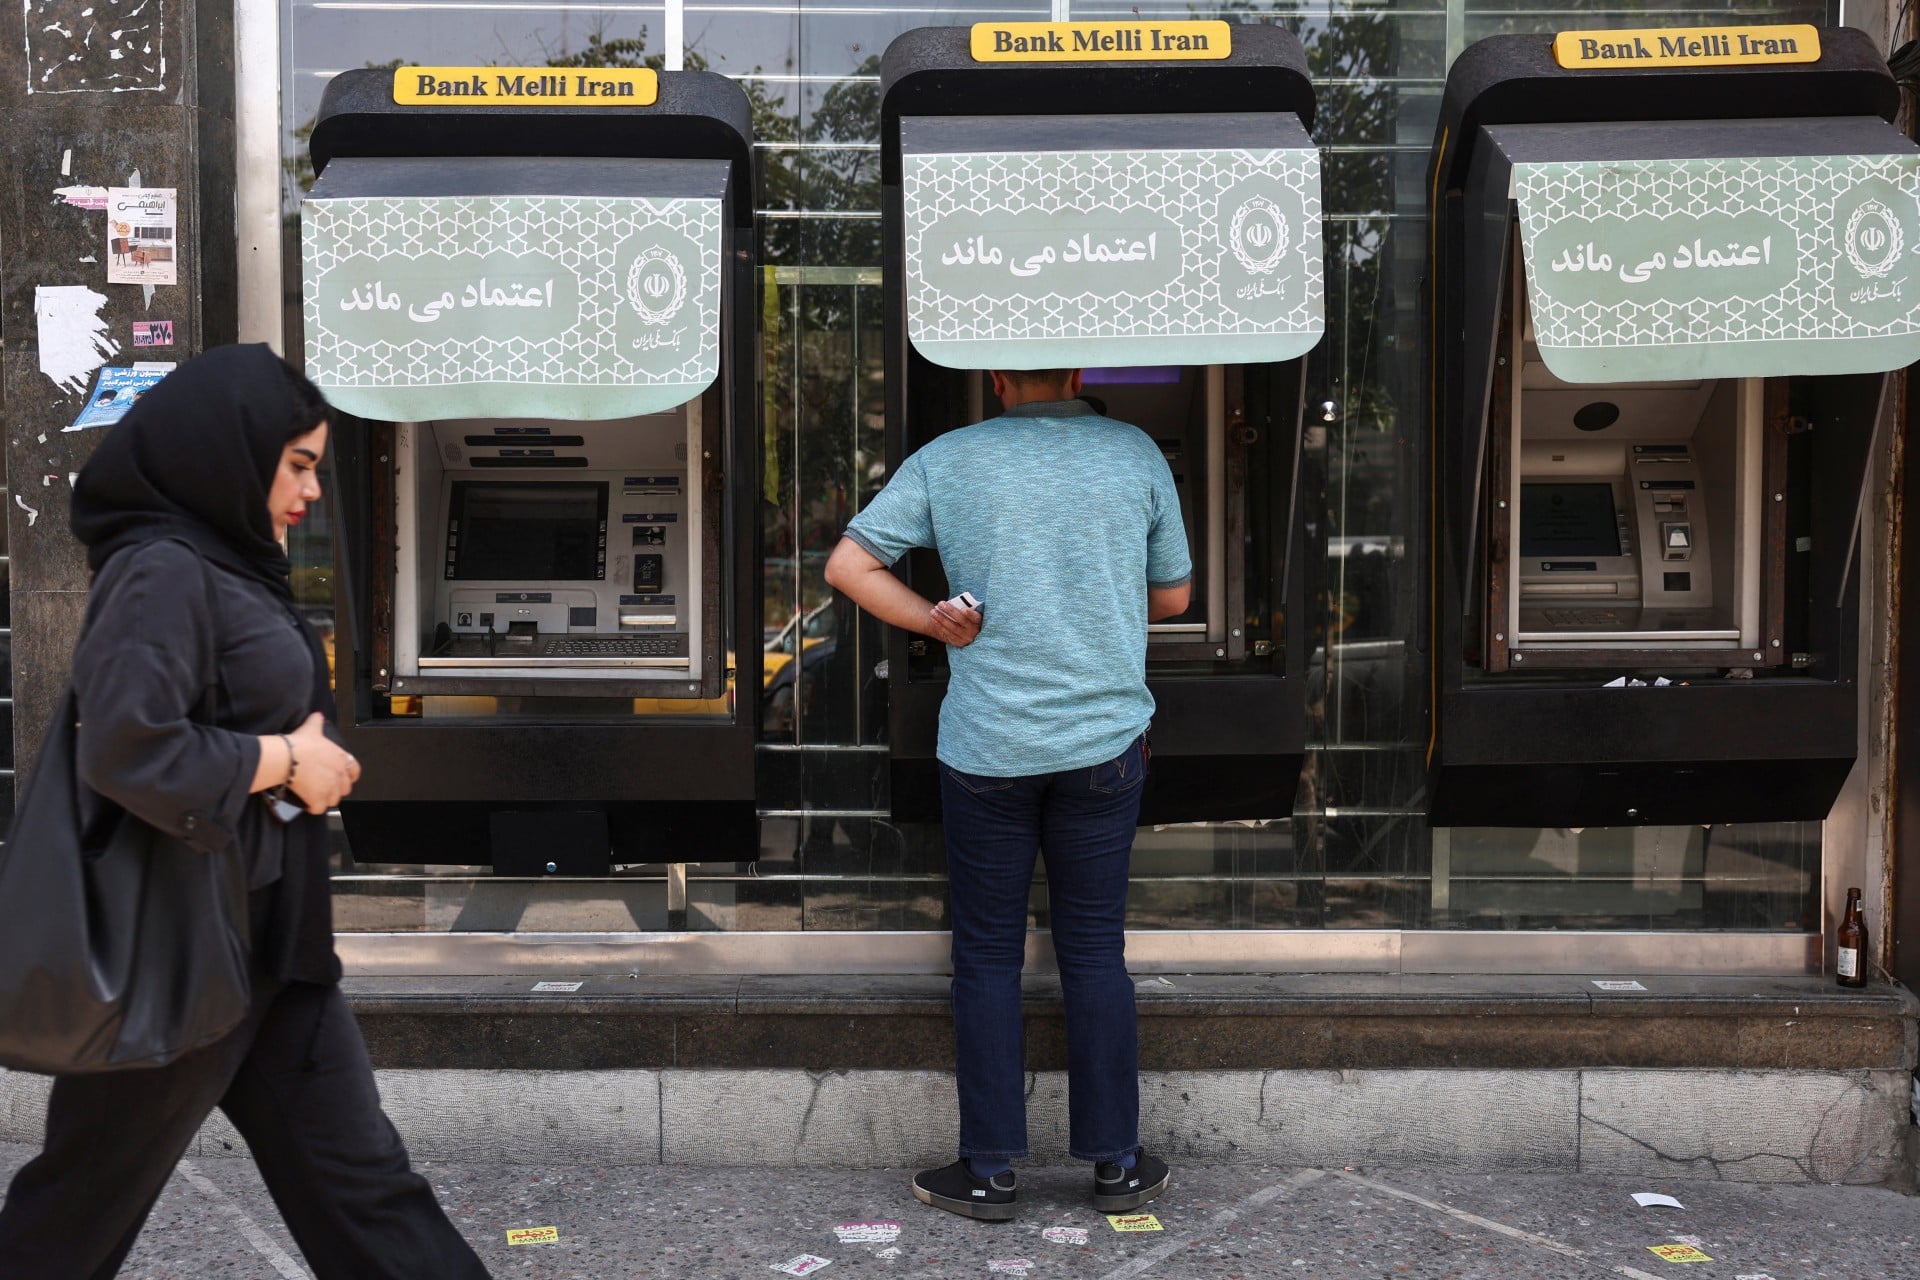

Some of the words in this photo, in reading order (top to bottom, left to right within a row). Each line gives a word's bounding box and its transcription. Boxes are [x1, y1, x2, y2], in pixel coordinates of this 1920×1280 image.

[993, 30, 1065, 52] Bank
[1072, 29, 1142, 51] Melli
[1150, 29, 1209, 51] Iran
[1578, 37, 1653, 60] Bank
[1658, 34, 1731, 58] Melli
[1737, 34, 1798, 56] Iran
[416, 74, 488, 96] Bank
[496, 75, 567, 97] Melli
[575, 75, 634, 97] Iran
[941, 235, 1003, 266] ماند
[1009, 245, 1056, 277] می
[1062, 231, 1157, 263] اعتماد
[1551, 241, 1613, 272] ماند
[1672, 235, 1771, 269] اعتماد
[1619, 251, 1667, 284] می
[340, 280, 401, 311] ماند
[408, 291, 455, 323] می
[461, 277, 554, 308] اعتماد
